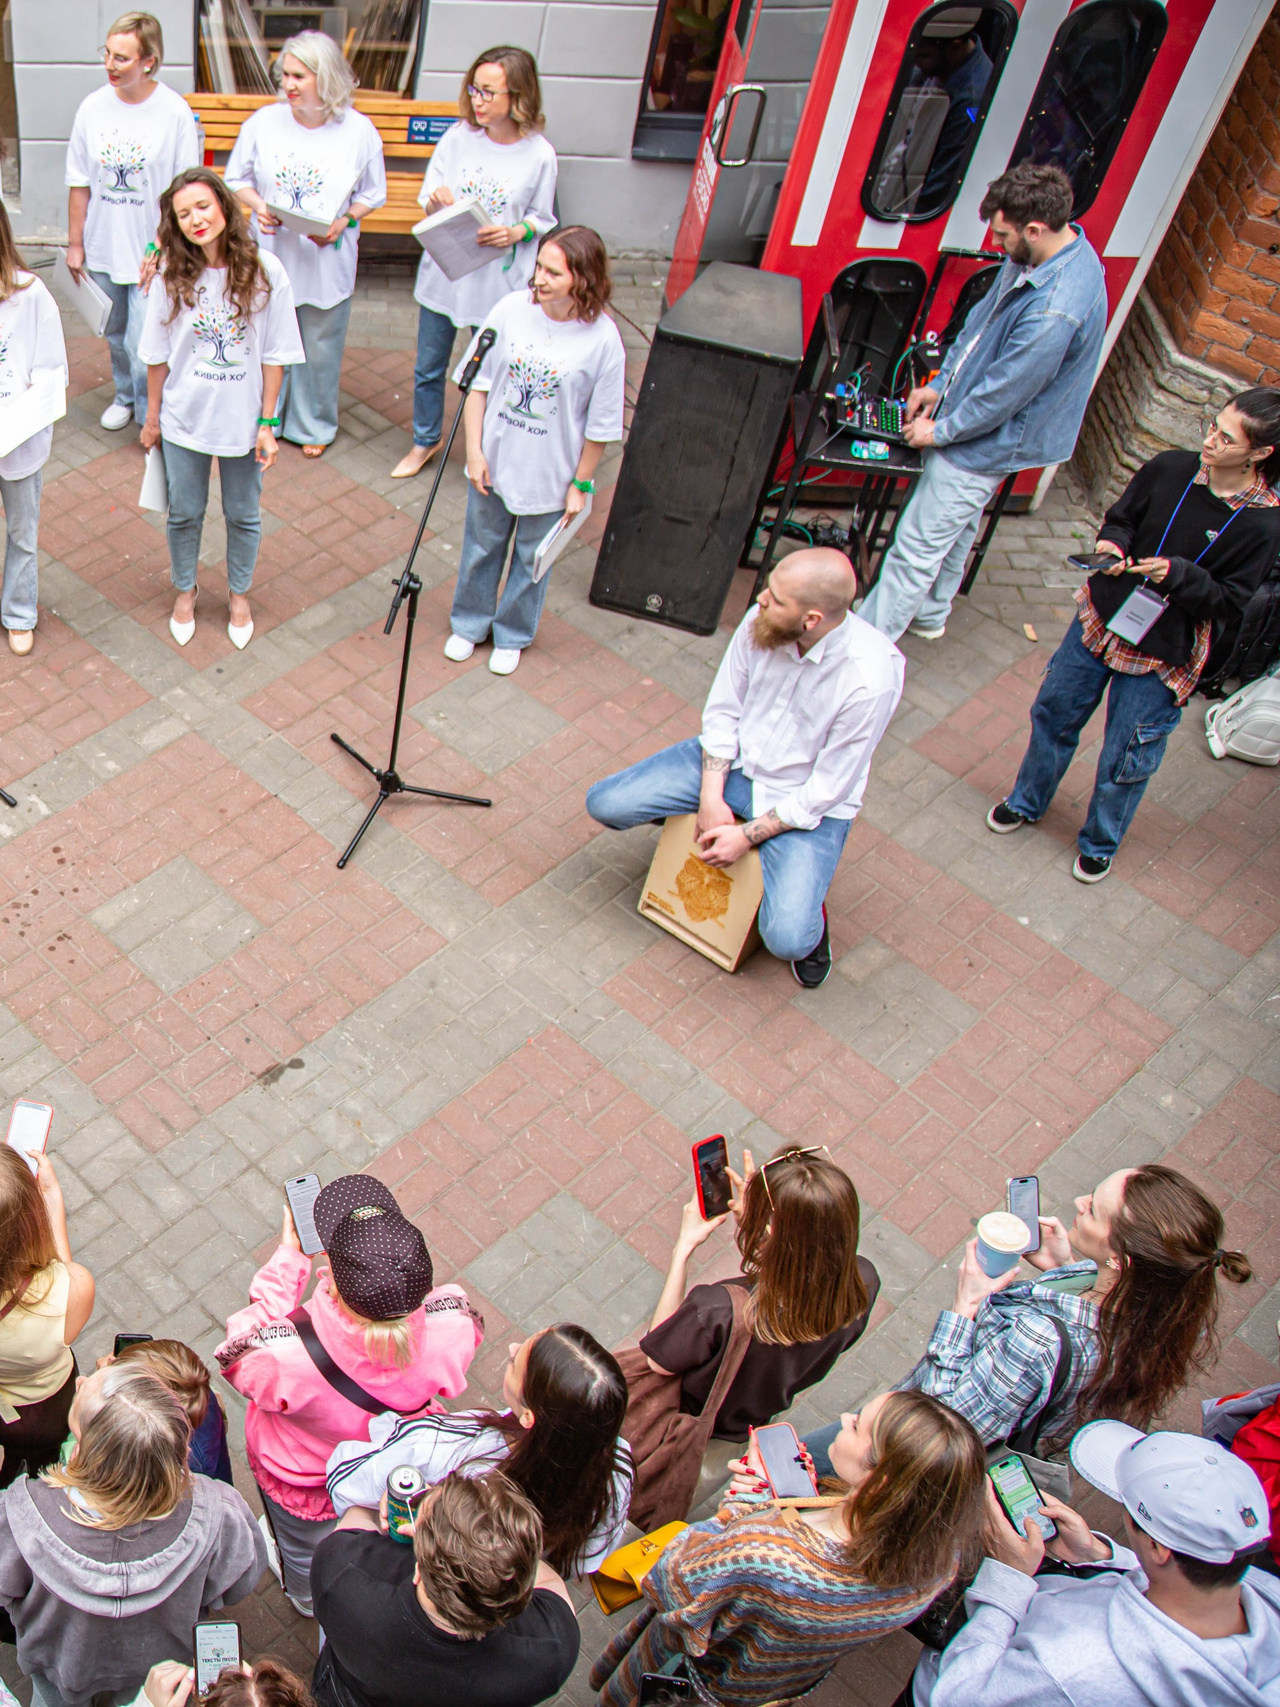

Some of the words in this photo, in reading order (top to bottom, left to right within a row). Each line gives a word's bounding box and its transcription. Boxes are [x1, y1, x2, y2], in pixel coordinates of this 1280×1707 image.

[193, 369, 226, 381] ЖИВОЙ
[229, 371, 247, 381] ХОР
[527, 425, 548, 436] ХОР
